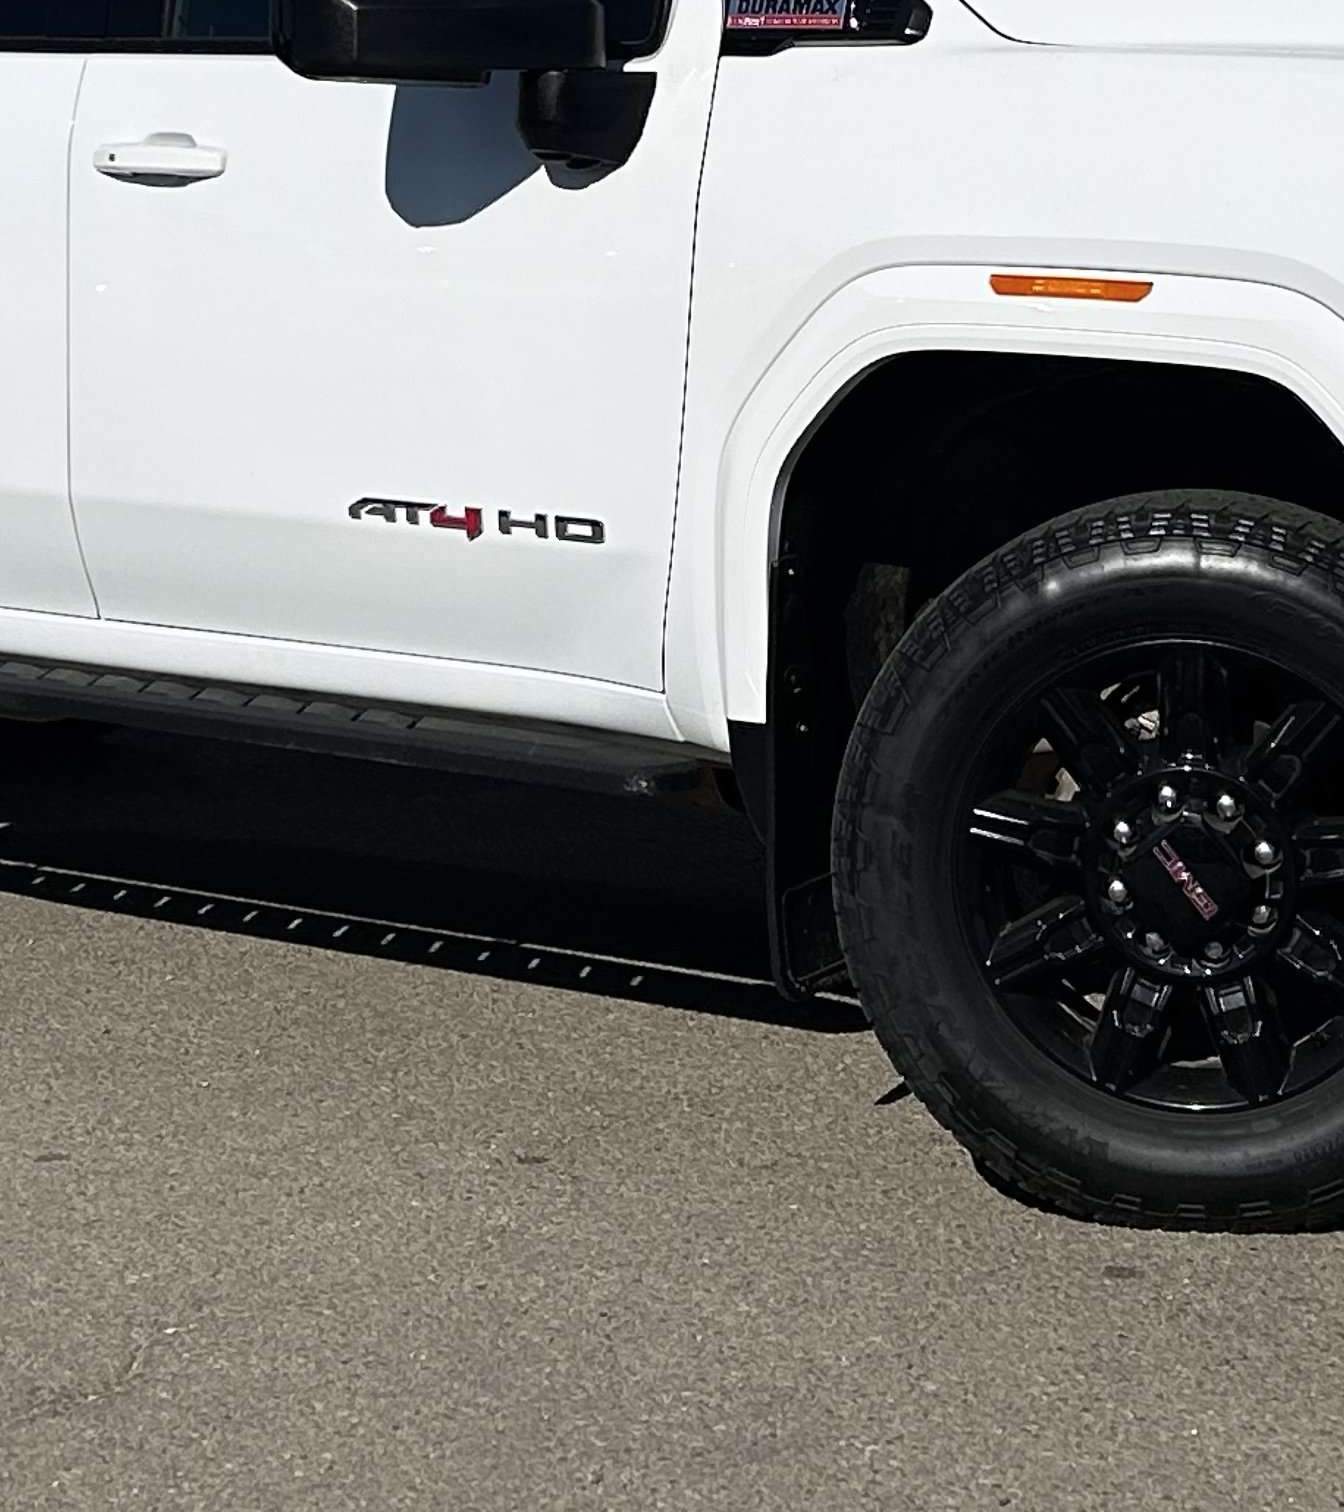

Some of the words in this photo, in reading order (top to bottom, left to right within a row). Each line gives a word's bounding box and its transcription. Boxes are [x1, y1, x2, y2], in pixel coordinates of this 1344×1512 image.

[347, 496, 485, 542] AT4
[497, 509, 606, 544] HD
[1152, 838, 1220, 921] GMC
